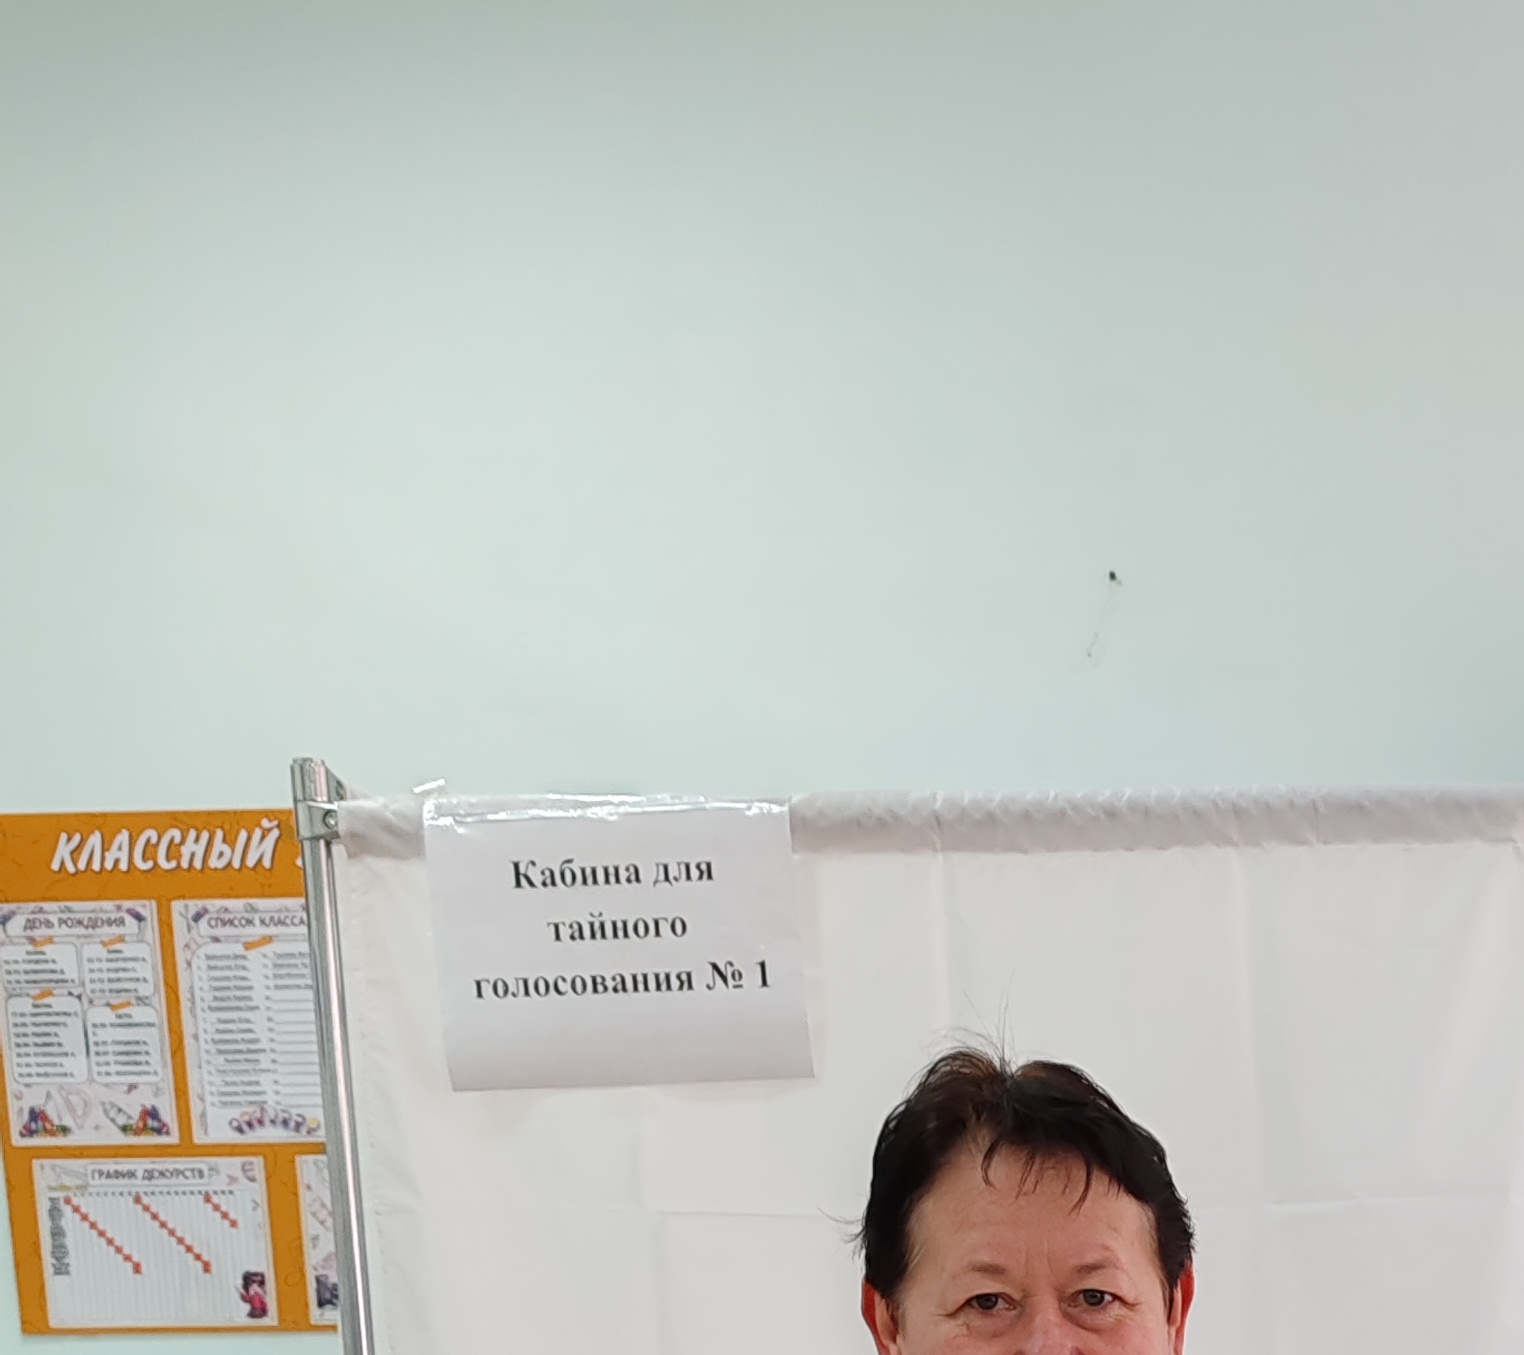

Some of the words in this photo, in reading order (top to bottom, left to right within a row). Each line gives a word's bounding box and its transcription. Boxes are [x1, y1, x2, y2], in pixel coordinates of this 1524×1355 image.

[51, 817, 281, 874] КЛАССНЫЙ
[509, 859, 642, 890] Кабина
[652, 859, 715, 888] для
[23, 917, 55, 932] ДЕНЬ
[58, 915, 127, 931] РОЖДЕНИЯ
[207, 915, 257, 929] СПИСОК
[260, 914, 308, 928] КЛАССА
[547, 911, 688, 942] тайного
[473, 969, 695, 1000] голосования
[705, 960, 746, 992] №
[756, 959, 772, 989] 1
[90, 1167, 138, 1181] ГРАФИК
